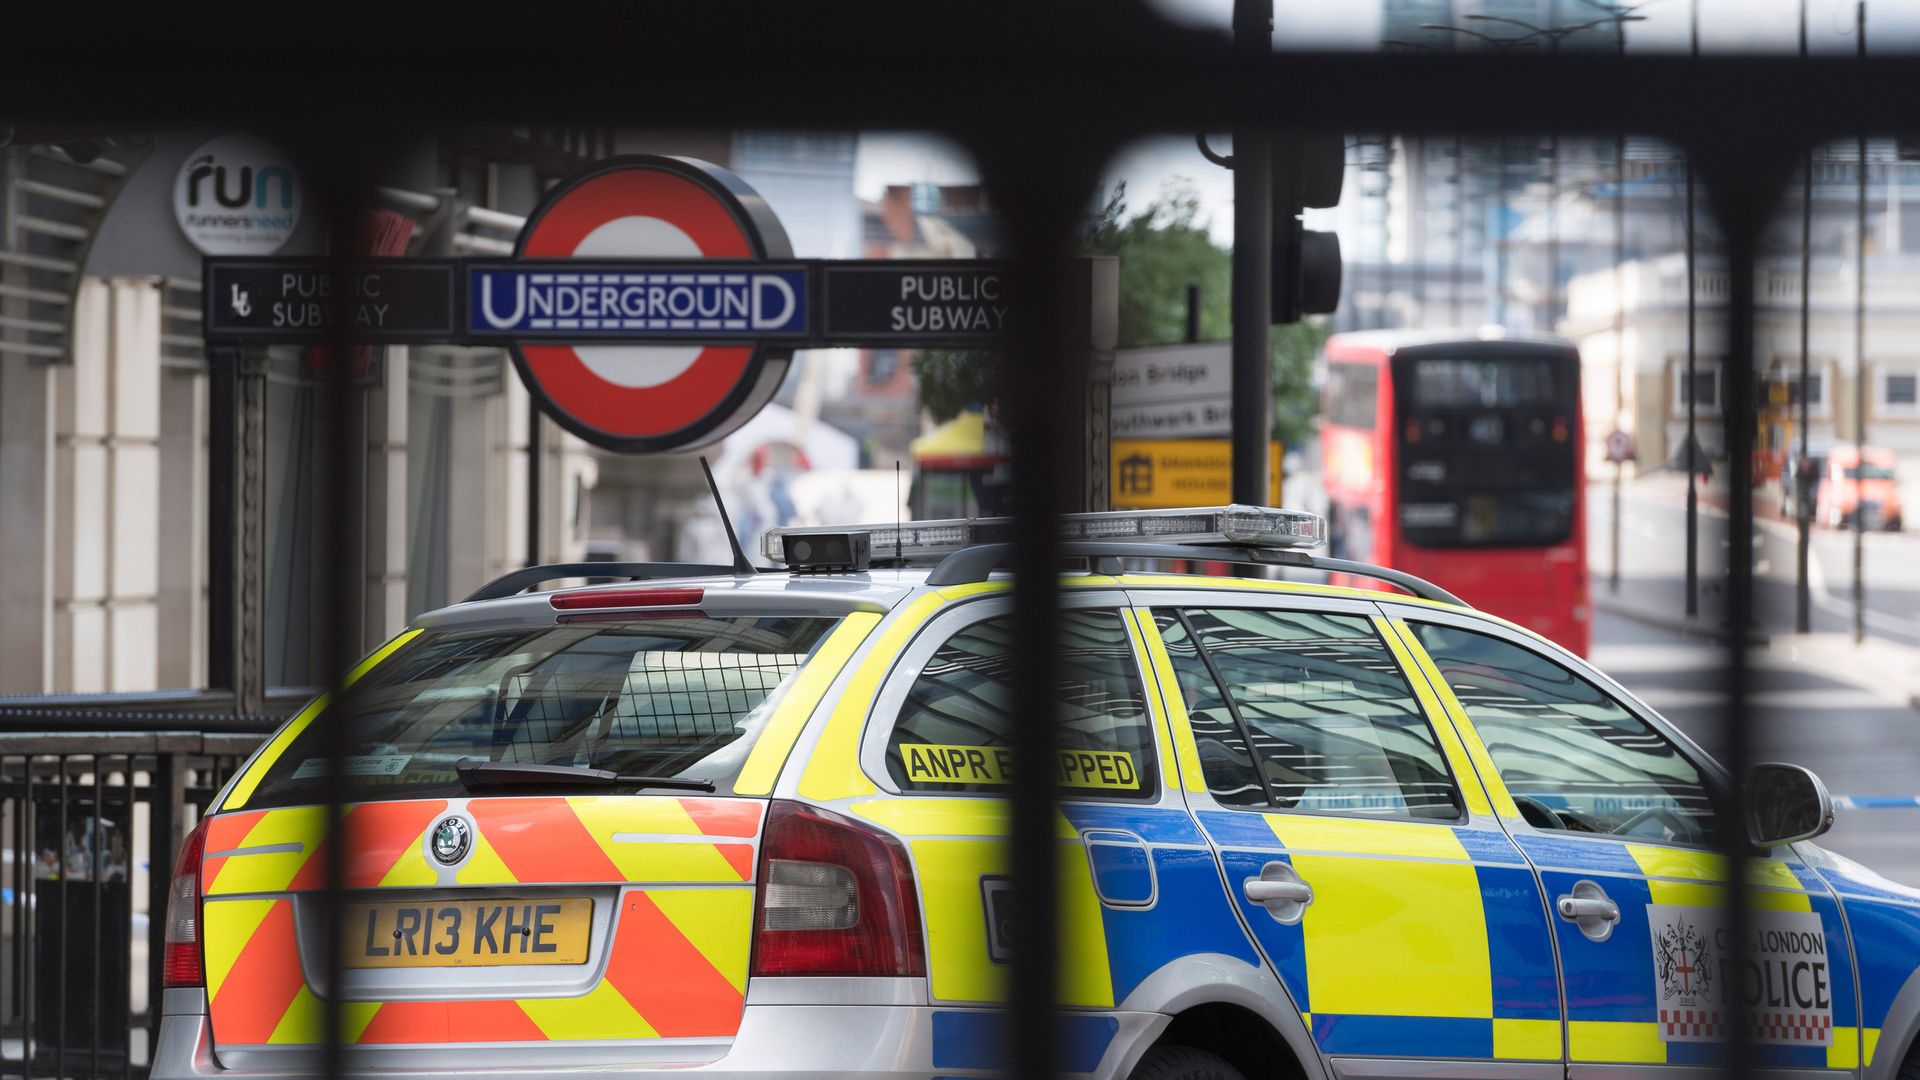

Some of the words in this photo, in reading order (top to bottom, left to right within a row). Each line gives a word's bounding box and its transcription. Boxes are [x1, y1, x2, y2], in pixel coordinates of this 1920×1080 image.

[187, 165, 293, 209] run
[282, 273, 380, 297] PUBIC
[901, 276, 999, 300] PUBLIC
[482, 274, 796, 329] UNDERGROUND
[272, 302, 389, 327] SUBAY
[891, 306, 1008, 331] SUBWAY
[1147, 362, 1209, 385] Bridge
[911, 748, 992, 779] ANPR
[994, 749, 1134, 785] EIPPED
[365, 907, 462, 956] LR13
[473, 904, 561, 954] KHE
[1759, 930, 1824, 955] LONDON
